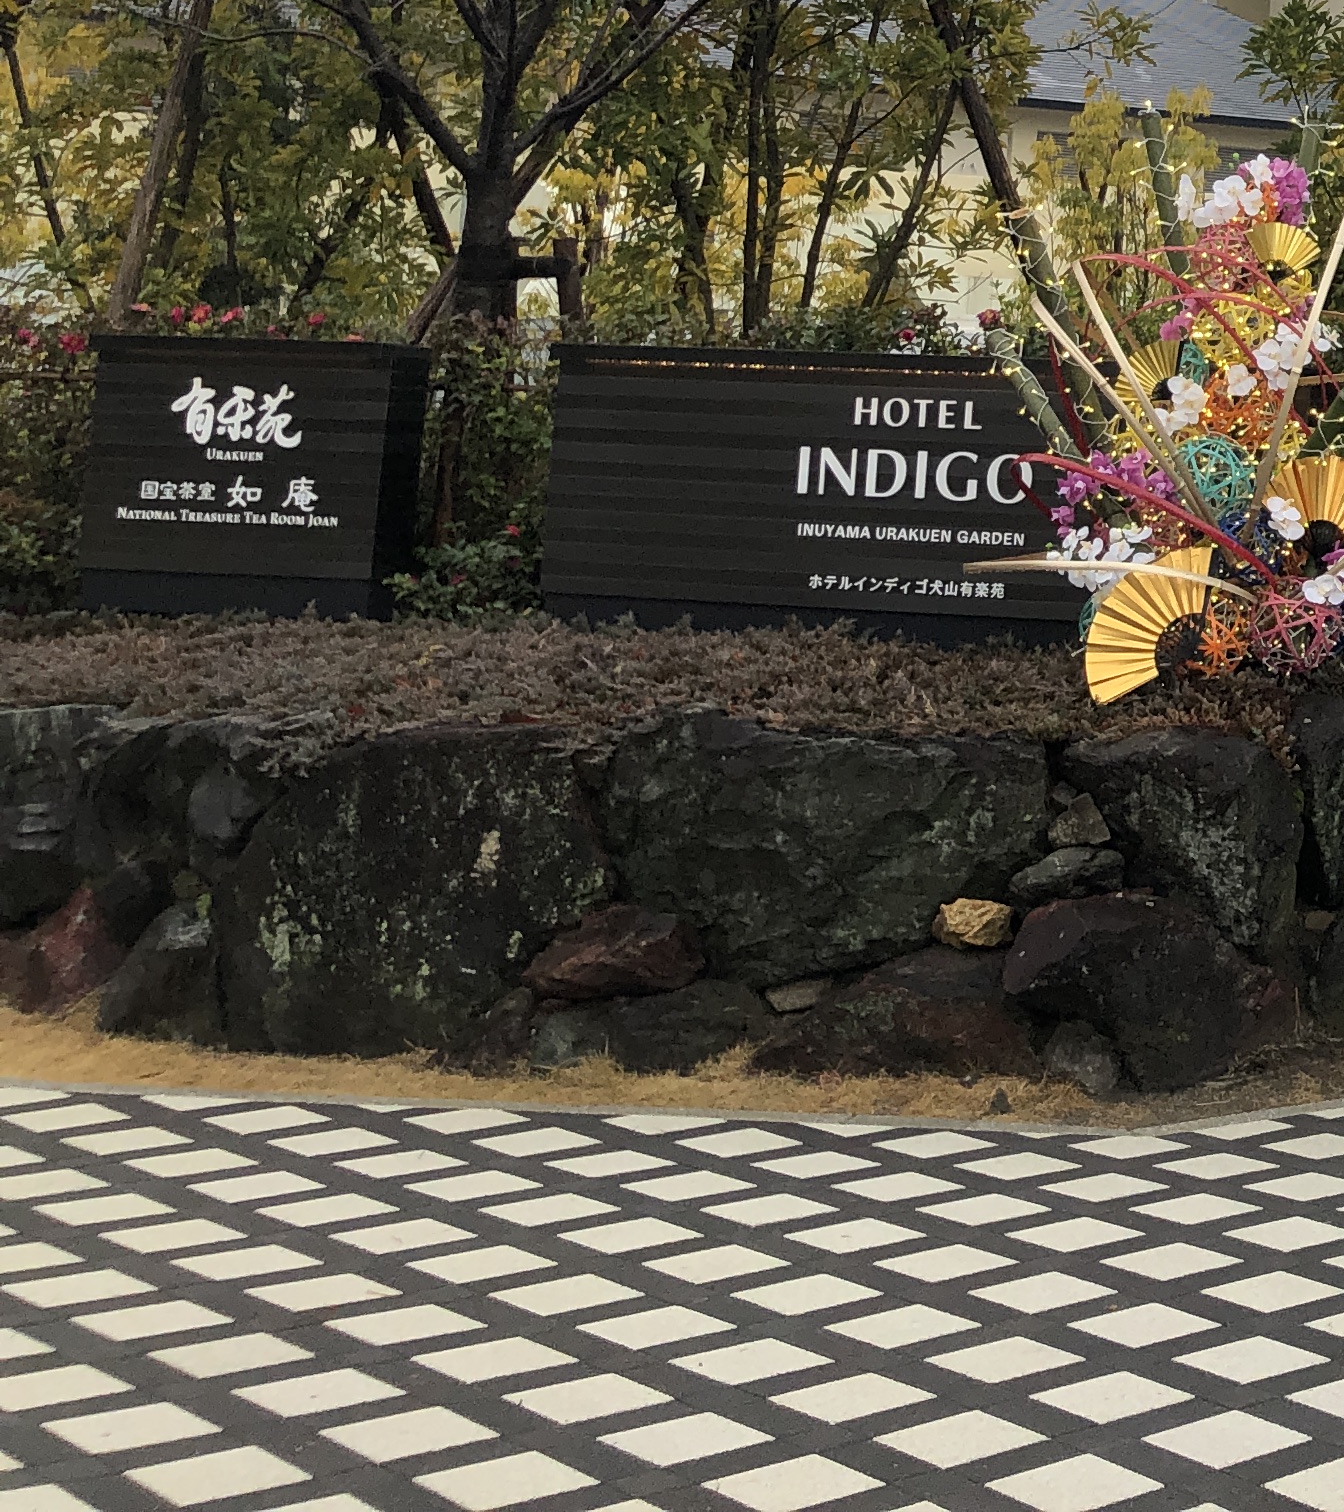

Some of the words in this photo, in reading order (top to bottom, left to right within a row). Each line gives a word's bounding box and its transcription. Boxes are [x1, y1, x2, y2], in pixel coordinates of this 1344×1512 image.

[854, 397, 982, 429] HOTEL
[797, 446, 1033, 504] INDIGO
[798, 523, 871, 539] INUYAMA
[876, 527, 951, 542] URAKUEN
[957, 531, 1024, 546] GARDEN
[809, 574, 1005, 598] ホテルインディゴ犬山有楽苑
